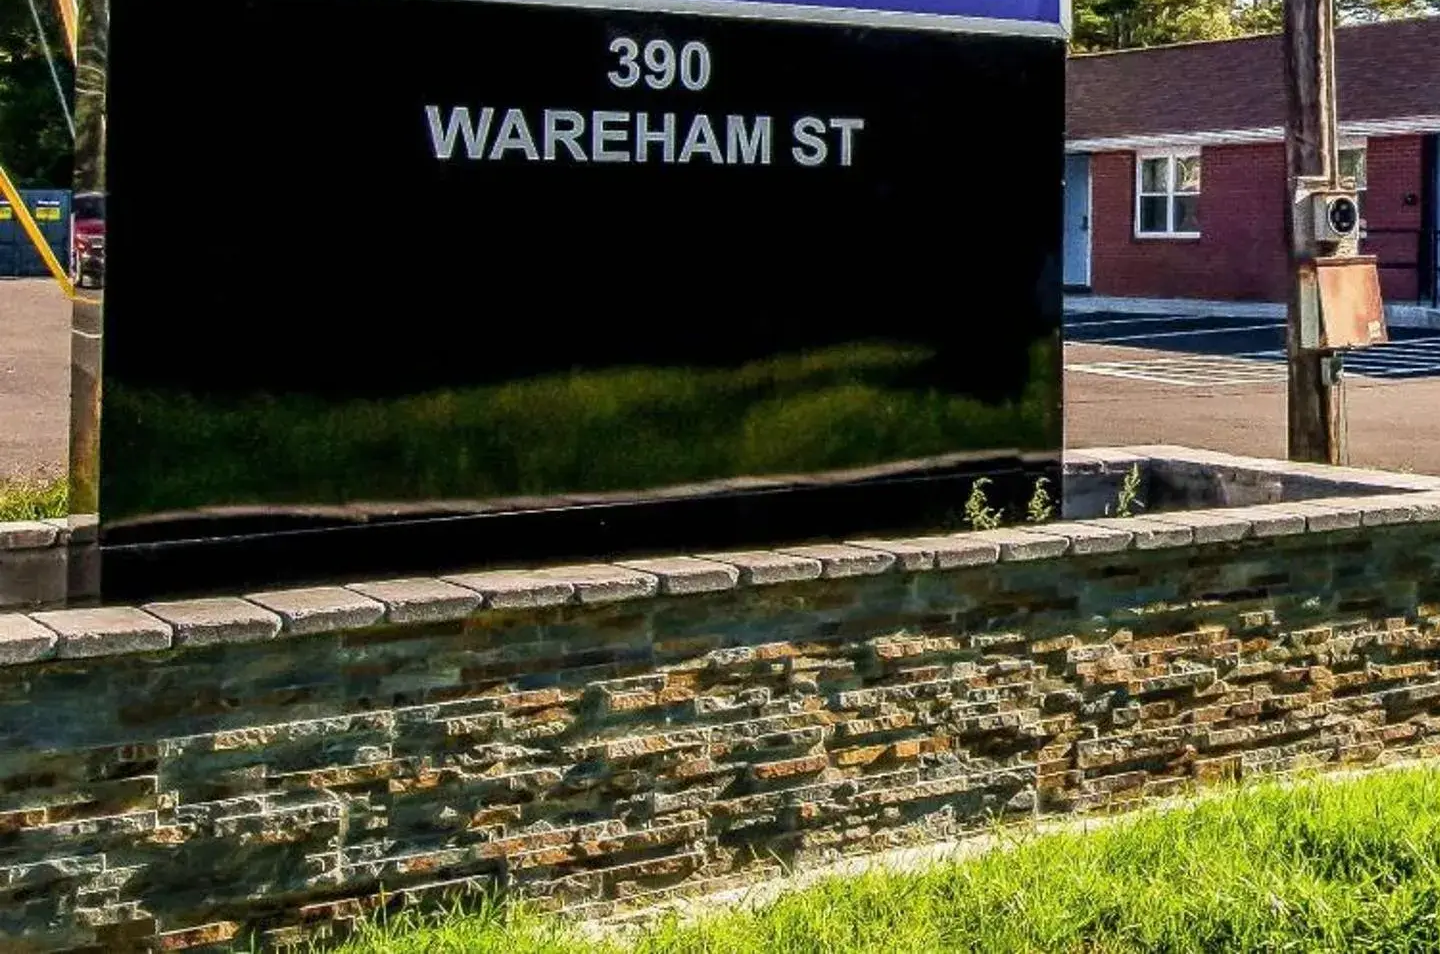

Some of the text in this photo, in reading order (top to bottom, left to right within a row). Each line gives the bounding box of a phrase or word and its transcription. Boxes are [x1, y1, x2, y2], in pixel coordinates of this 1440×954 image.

[606, 36, 712, 92] 390
[424, 104, 865, 167] WAREHAM ST
